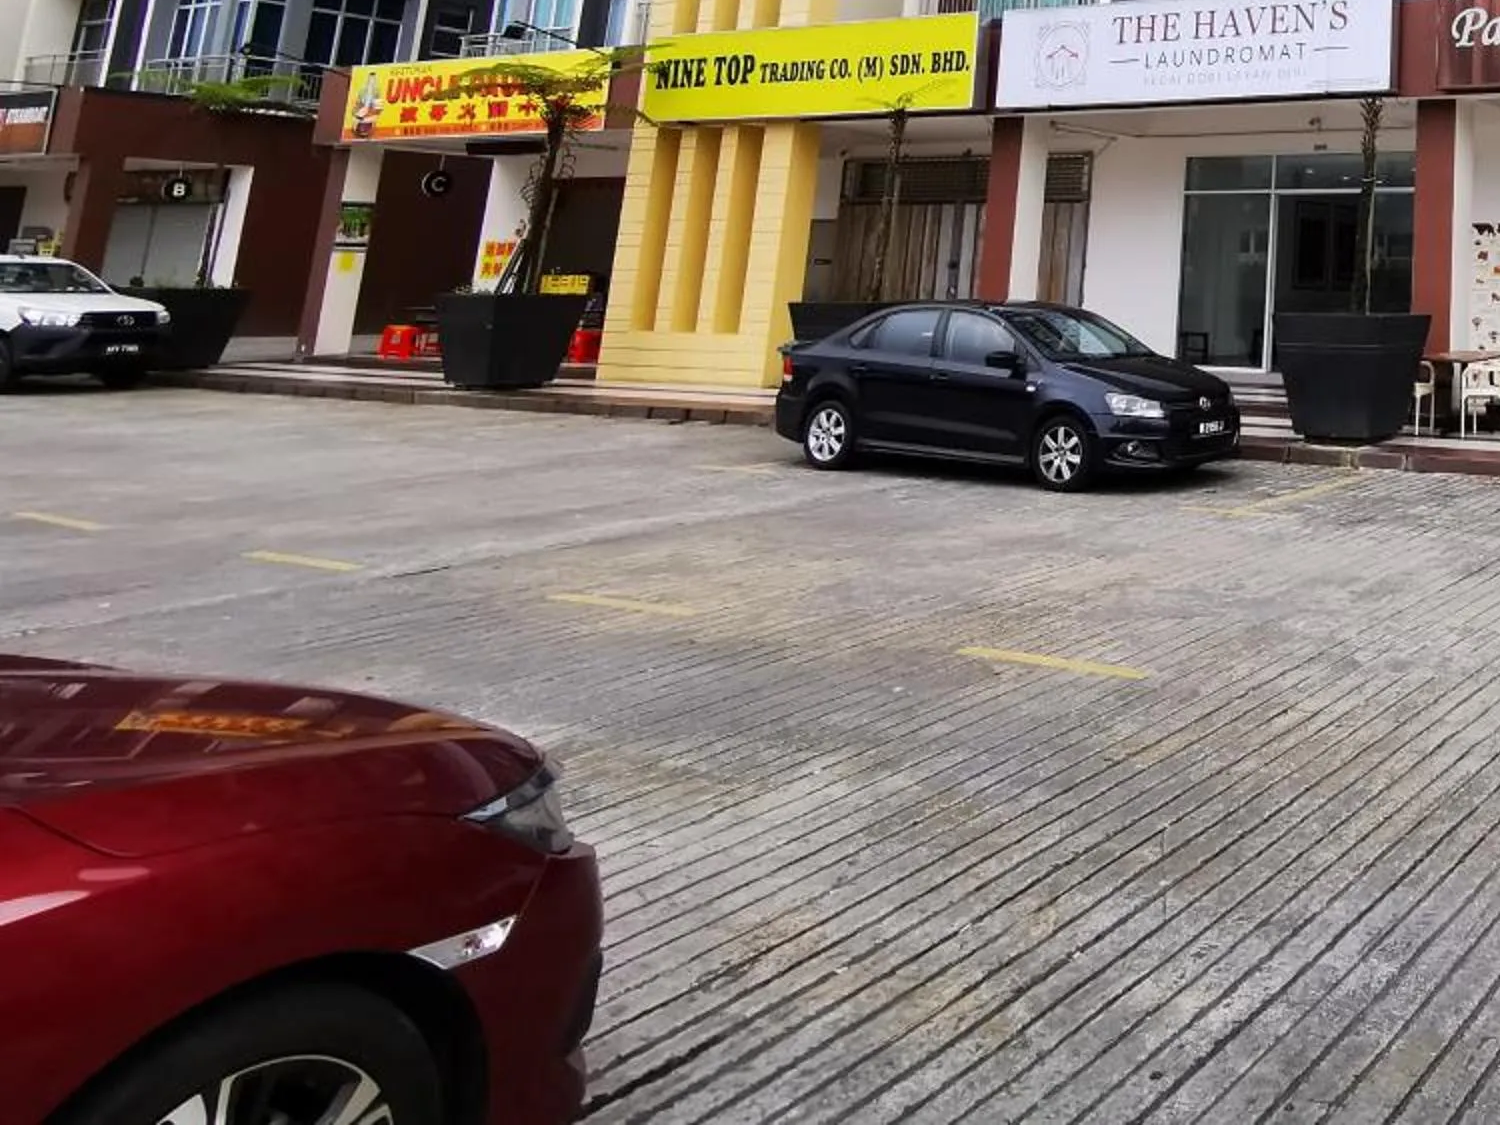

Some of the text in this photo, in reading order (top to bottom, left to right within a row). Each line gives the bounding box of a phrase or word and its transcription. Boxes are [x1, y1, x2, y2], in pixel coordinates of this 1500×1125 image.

[1112, 0, 1349, 44] THE HAVEN'S
[655, 50, 969, 89] NINE TOP TRADING CO. (M) SDN. BHD.
[1144, 43, 1307, 70] LAUNDROMAT
[173, 184, 186, 196] B
[431, 176, 447, 192] C
